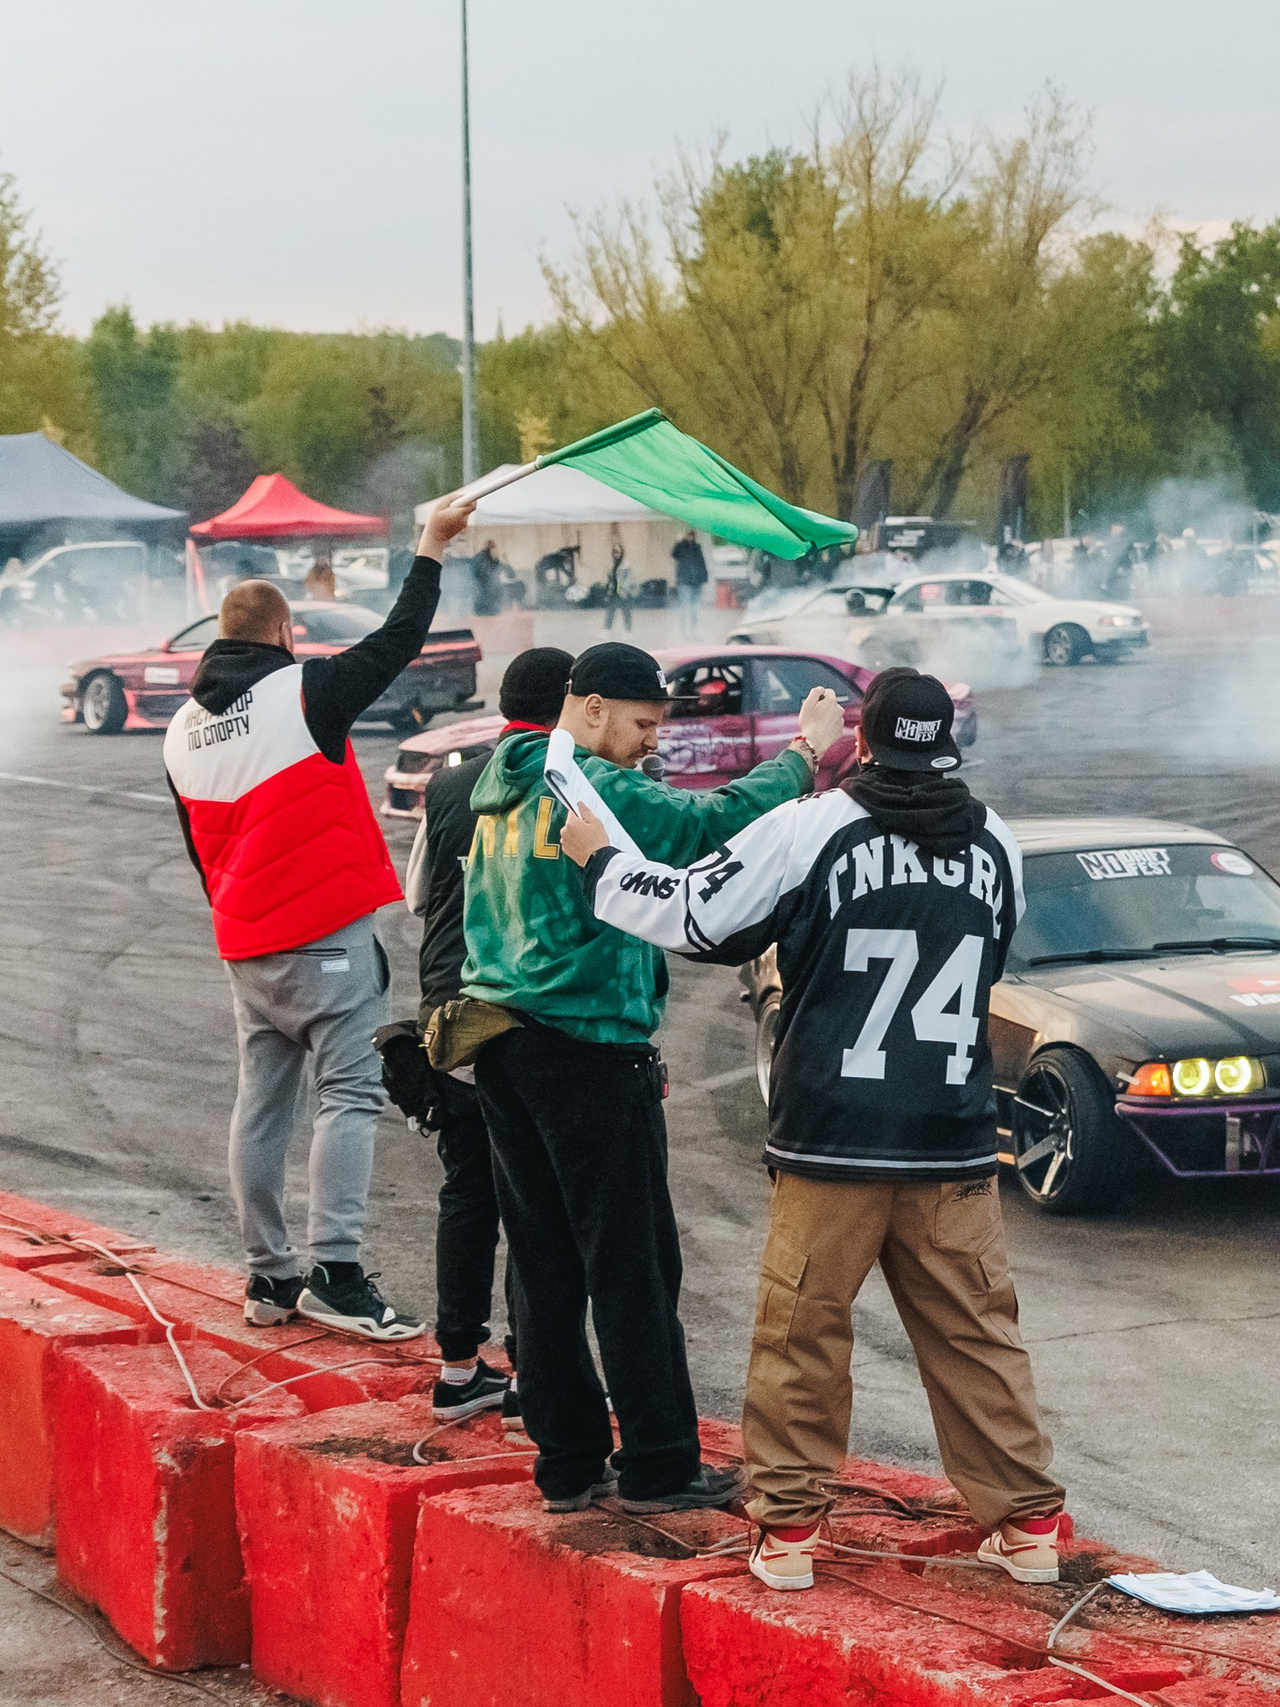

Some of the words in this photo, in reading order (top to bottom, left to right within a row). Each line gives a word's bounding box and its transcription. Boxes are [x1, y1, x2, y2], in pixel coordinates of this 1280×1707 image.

[187, 730, 201, 751] ПО
[203, 714, 250, 746] СПОРТУ
[917, 730, 937, 742] FEST
[1120, 848, 1170, 863] DRIFT
[1129, 861, 1172, 876] FEST
[841, 928, 984, 1085] 74
